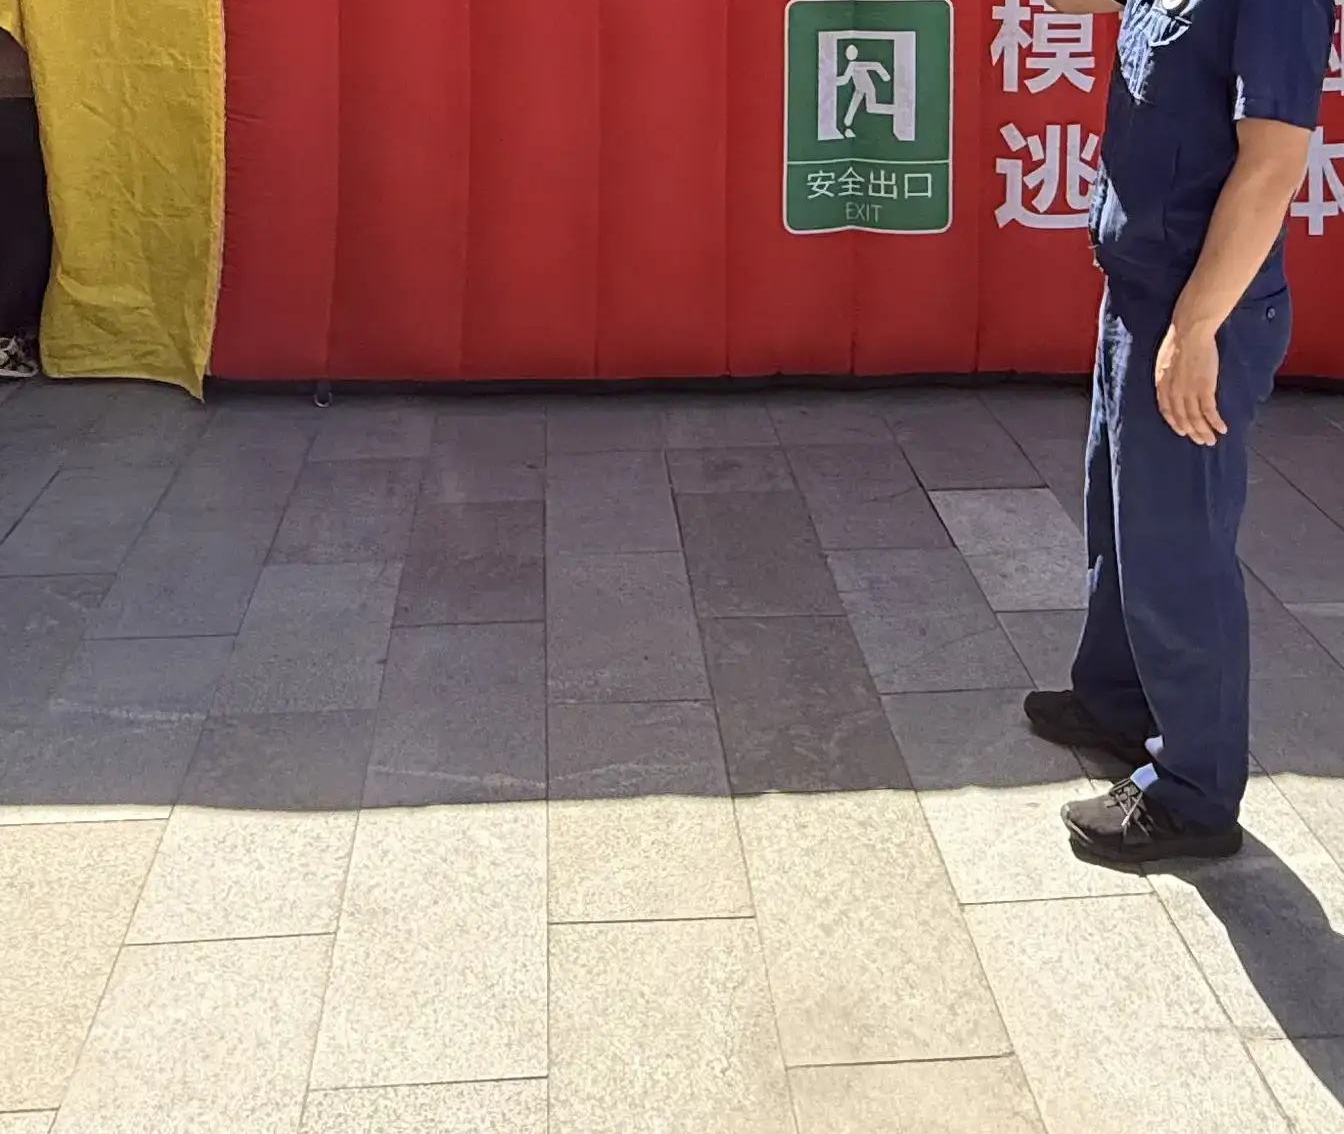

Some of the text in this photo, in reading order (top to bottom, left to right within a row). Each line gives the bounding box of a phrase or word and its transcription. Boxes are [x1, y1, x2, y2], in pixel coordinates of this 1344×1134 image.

[806, 166, 933, 199] 安全出口
[845, 201, 883, 223] EXIT
